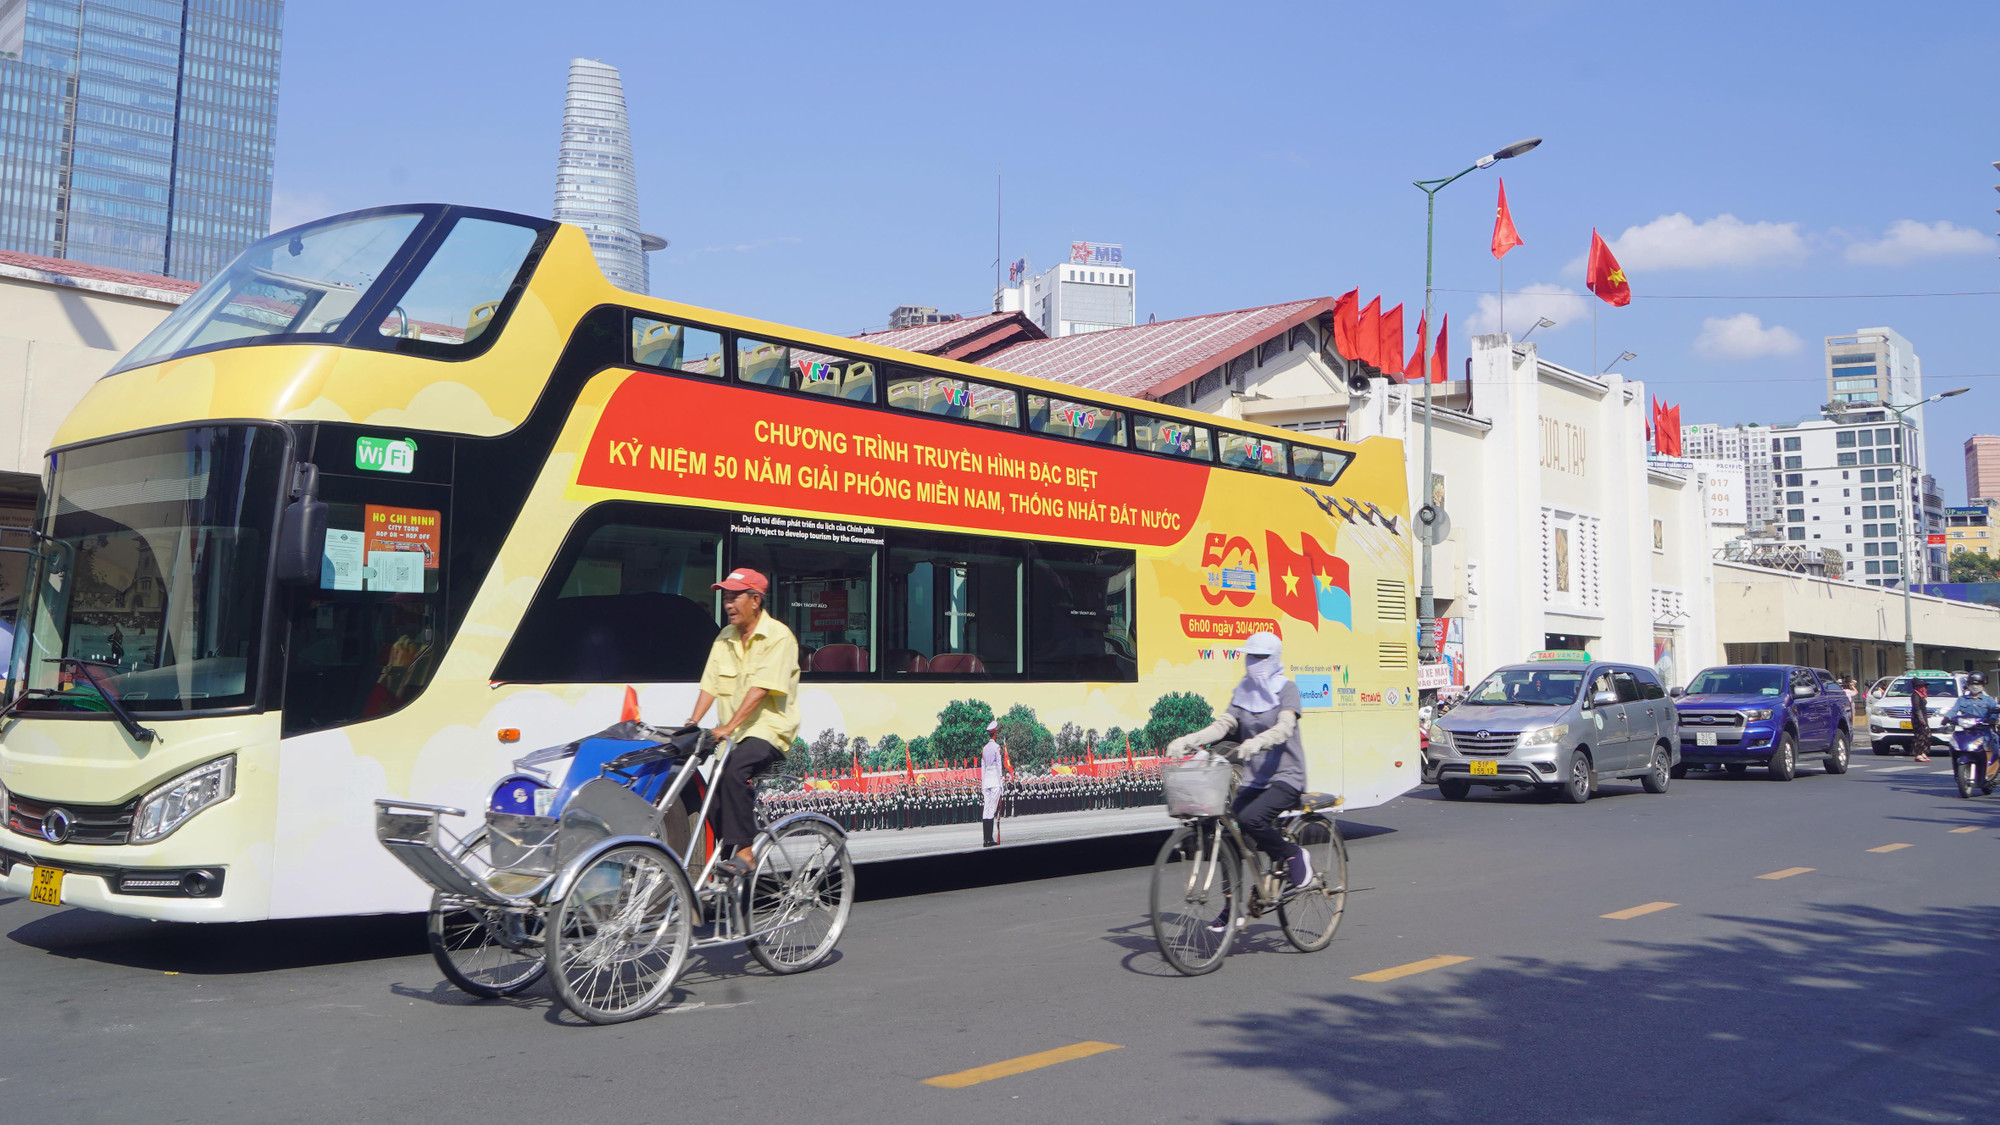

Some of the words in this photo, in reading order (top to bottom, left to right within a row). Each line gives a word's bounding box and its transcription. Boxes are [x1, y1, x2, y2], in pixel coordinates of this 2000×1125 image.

[1095, 246, 1122, 262] MB
[798, 359, 830, 382] VTV
[942, 386, 974, 408] VTV1
[1063, 409, 1094, 430] VTV9
[755, 420, 847, 454] CHƯƠNG
[853, 433, 908, 463] TRÌNH
[914, 444, 982, 473] TRUYỀN
[988, 452, 1025, 479] HÌNH
[1029, 461, 1061, 487] ĐẶC
[1066, 466, 1097, 492] BIỆT
[609, 437, 643, 467] KỶ
[650, 446, 707, 478] NIỆM
[713, 455, 738, 479] 50
[744, 456, 791, 486] NĂM
[797, 464, 838, 491] GIẢI
[844, 471, 911, 500] PHÓNG
[917, 480, 958, 506] MIỀN
[964, 488, 1005, 515] NAM,
[1009, 491, 1064, 518] THỐNG
[1068, 499, 1106, 522] NHẤT
[1109, 504, 1137, 526] ĐẤT
[1141, 509, 1180, 530] NƯỚC
[1710, 479, 1729, 487] 017
[1711, 494, 1730, 502] 404
[372, 512, 386, 523] HO
[390, 514, 407, 524] CHI
[411, 515, 435, 526] MINH
[1712, 508, 1729, 517] 751
[752, 515, 760, 524] án
[771, 516, 786, 526] điểm
[787, 518, 801, 528] phát
[802, 519, 815, 529] triển
[816, 520, 824, 529] du
[825, 521, 835, 532] lịch
[836, 523, 846, 532] của
[847, 524, 863, 533] Chính
[863, 526, 875, 535] phủ
[731, 525, 754, 535] Priority
[755, 527, 777, 538] Project
[778, 529, 784, 537] to
[785, 530, 809, 540] develop
[810, 532, 831, 541] tourism
[833, 533, 840, 543] by
[841, 534, 850, 542] the
[851, 536, 884, 545] Government
[1188, 618, 1211, 632] 6h00
[1212, 620, 1234, 636] ngày
[1235, 621, 1275, 634] 30/4/2025
[1425, 669, 1433, 677] XE
[40, 869, 55, 885] 50F
